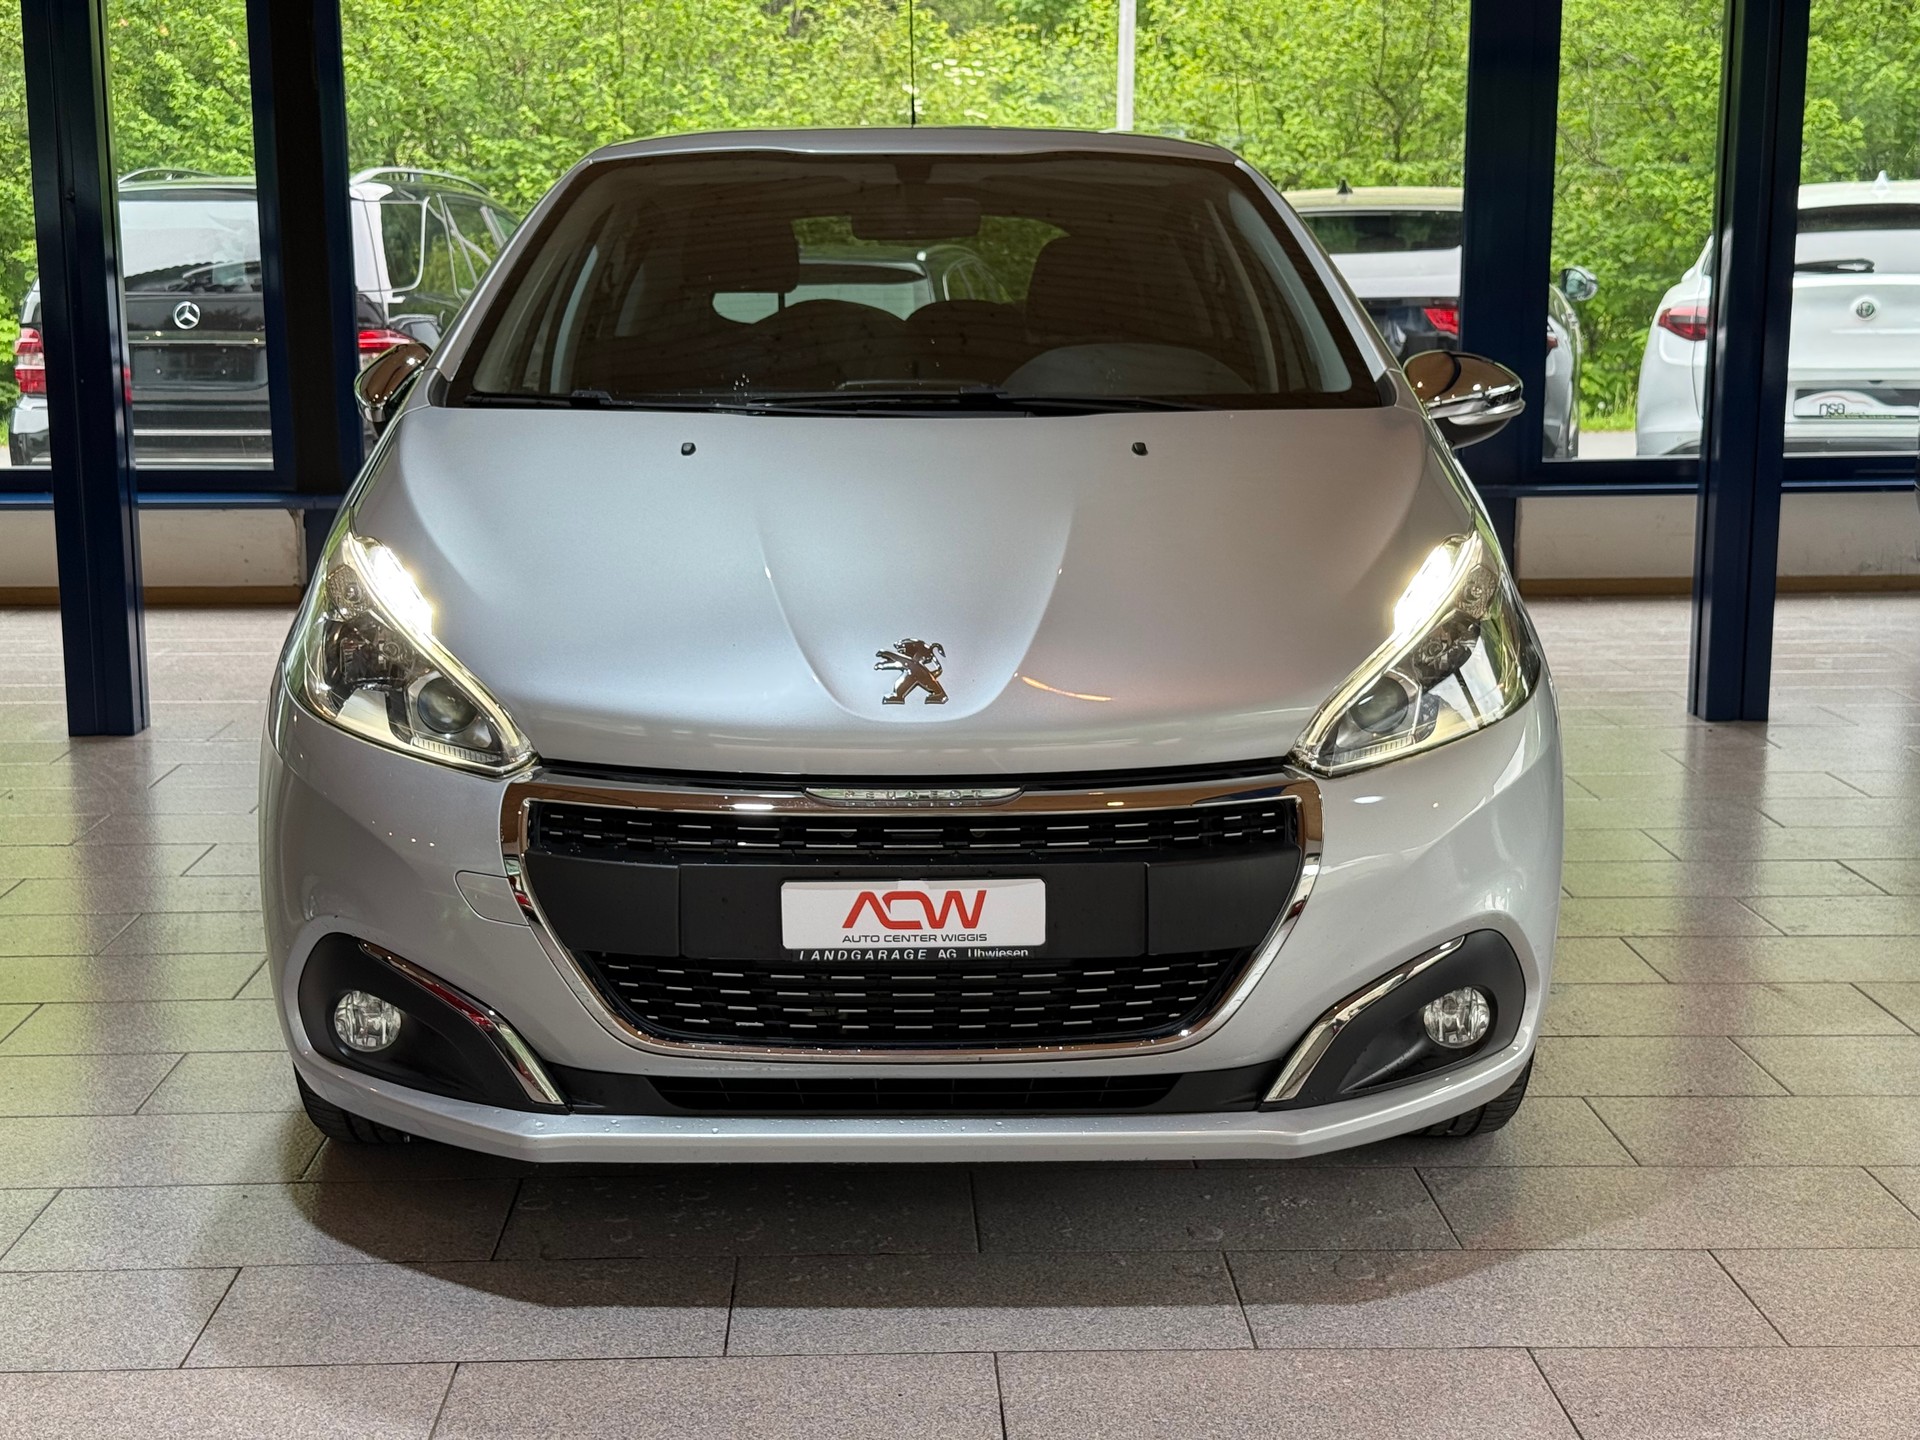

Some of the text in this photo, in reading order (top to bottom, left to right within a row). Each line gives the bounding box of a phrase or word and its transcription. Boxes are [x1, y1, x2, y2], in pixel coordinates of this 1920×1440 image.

[841, 933, 988, 944] AUTO CENTER WIGGIS
[937, 948, 957, 959] AG
